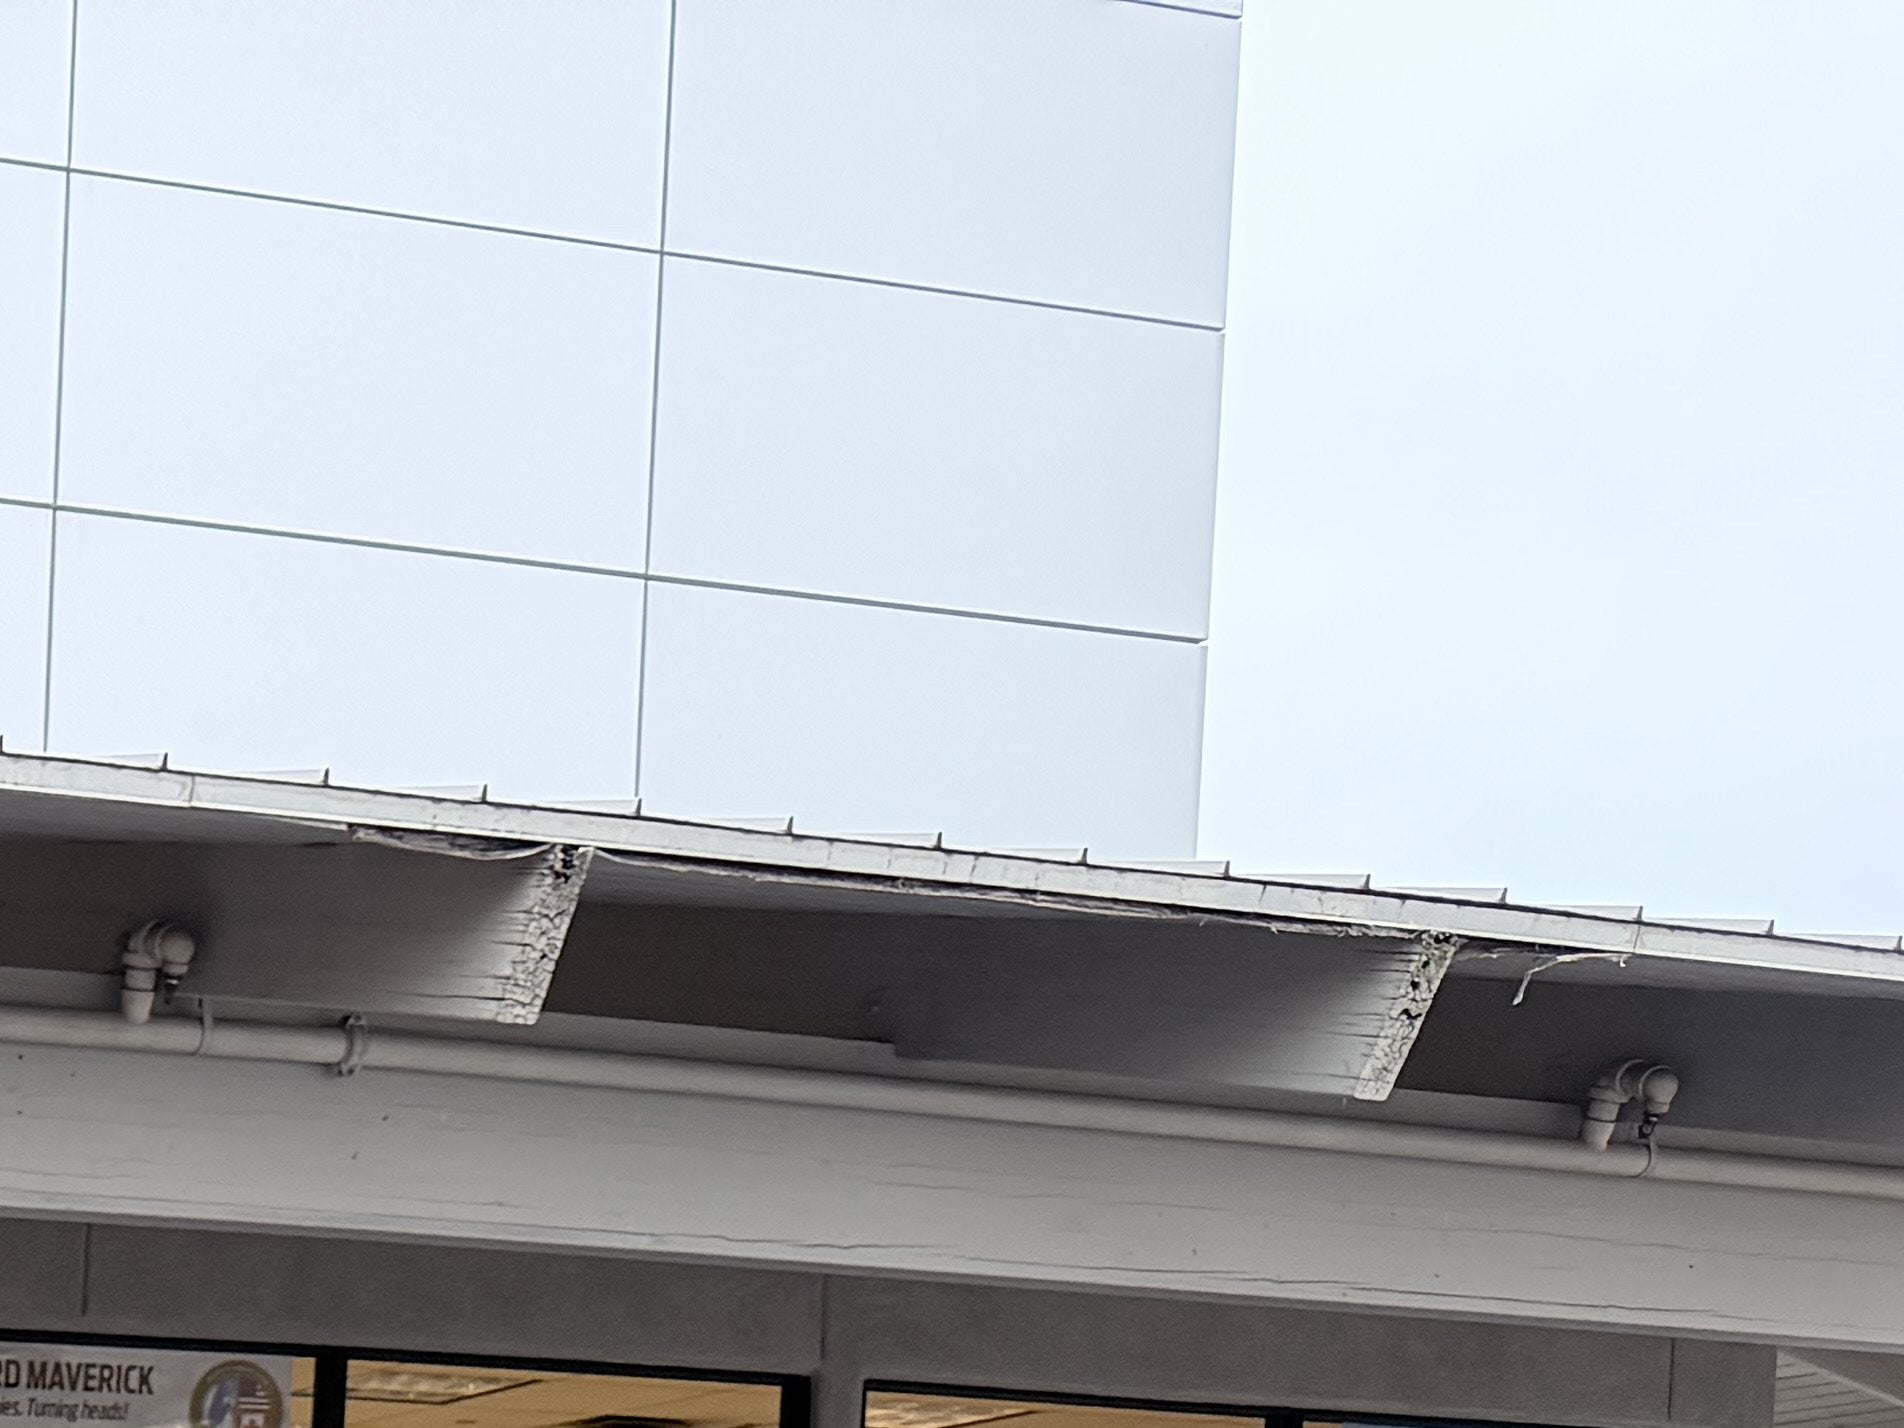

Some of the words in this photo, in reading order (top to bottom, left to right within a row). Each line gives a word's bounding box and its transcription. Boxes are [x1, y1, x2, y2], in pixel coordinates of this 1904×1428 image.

[26, 1360, 154, 1396] MAVERICK
[27, 1398, 79, 1422] Turning
[81, 1399, 129, 1421] heads!
